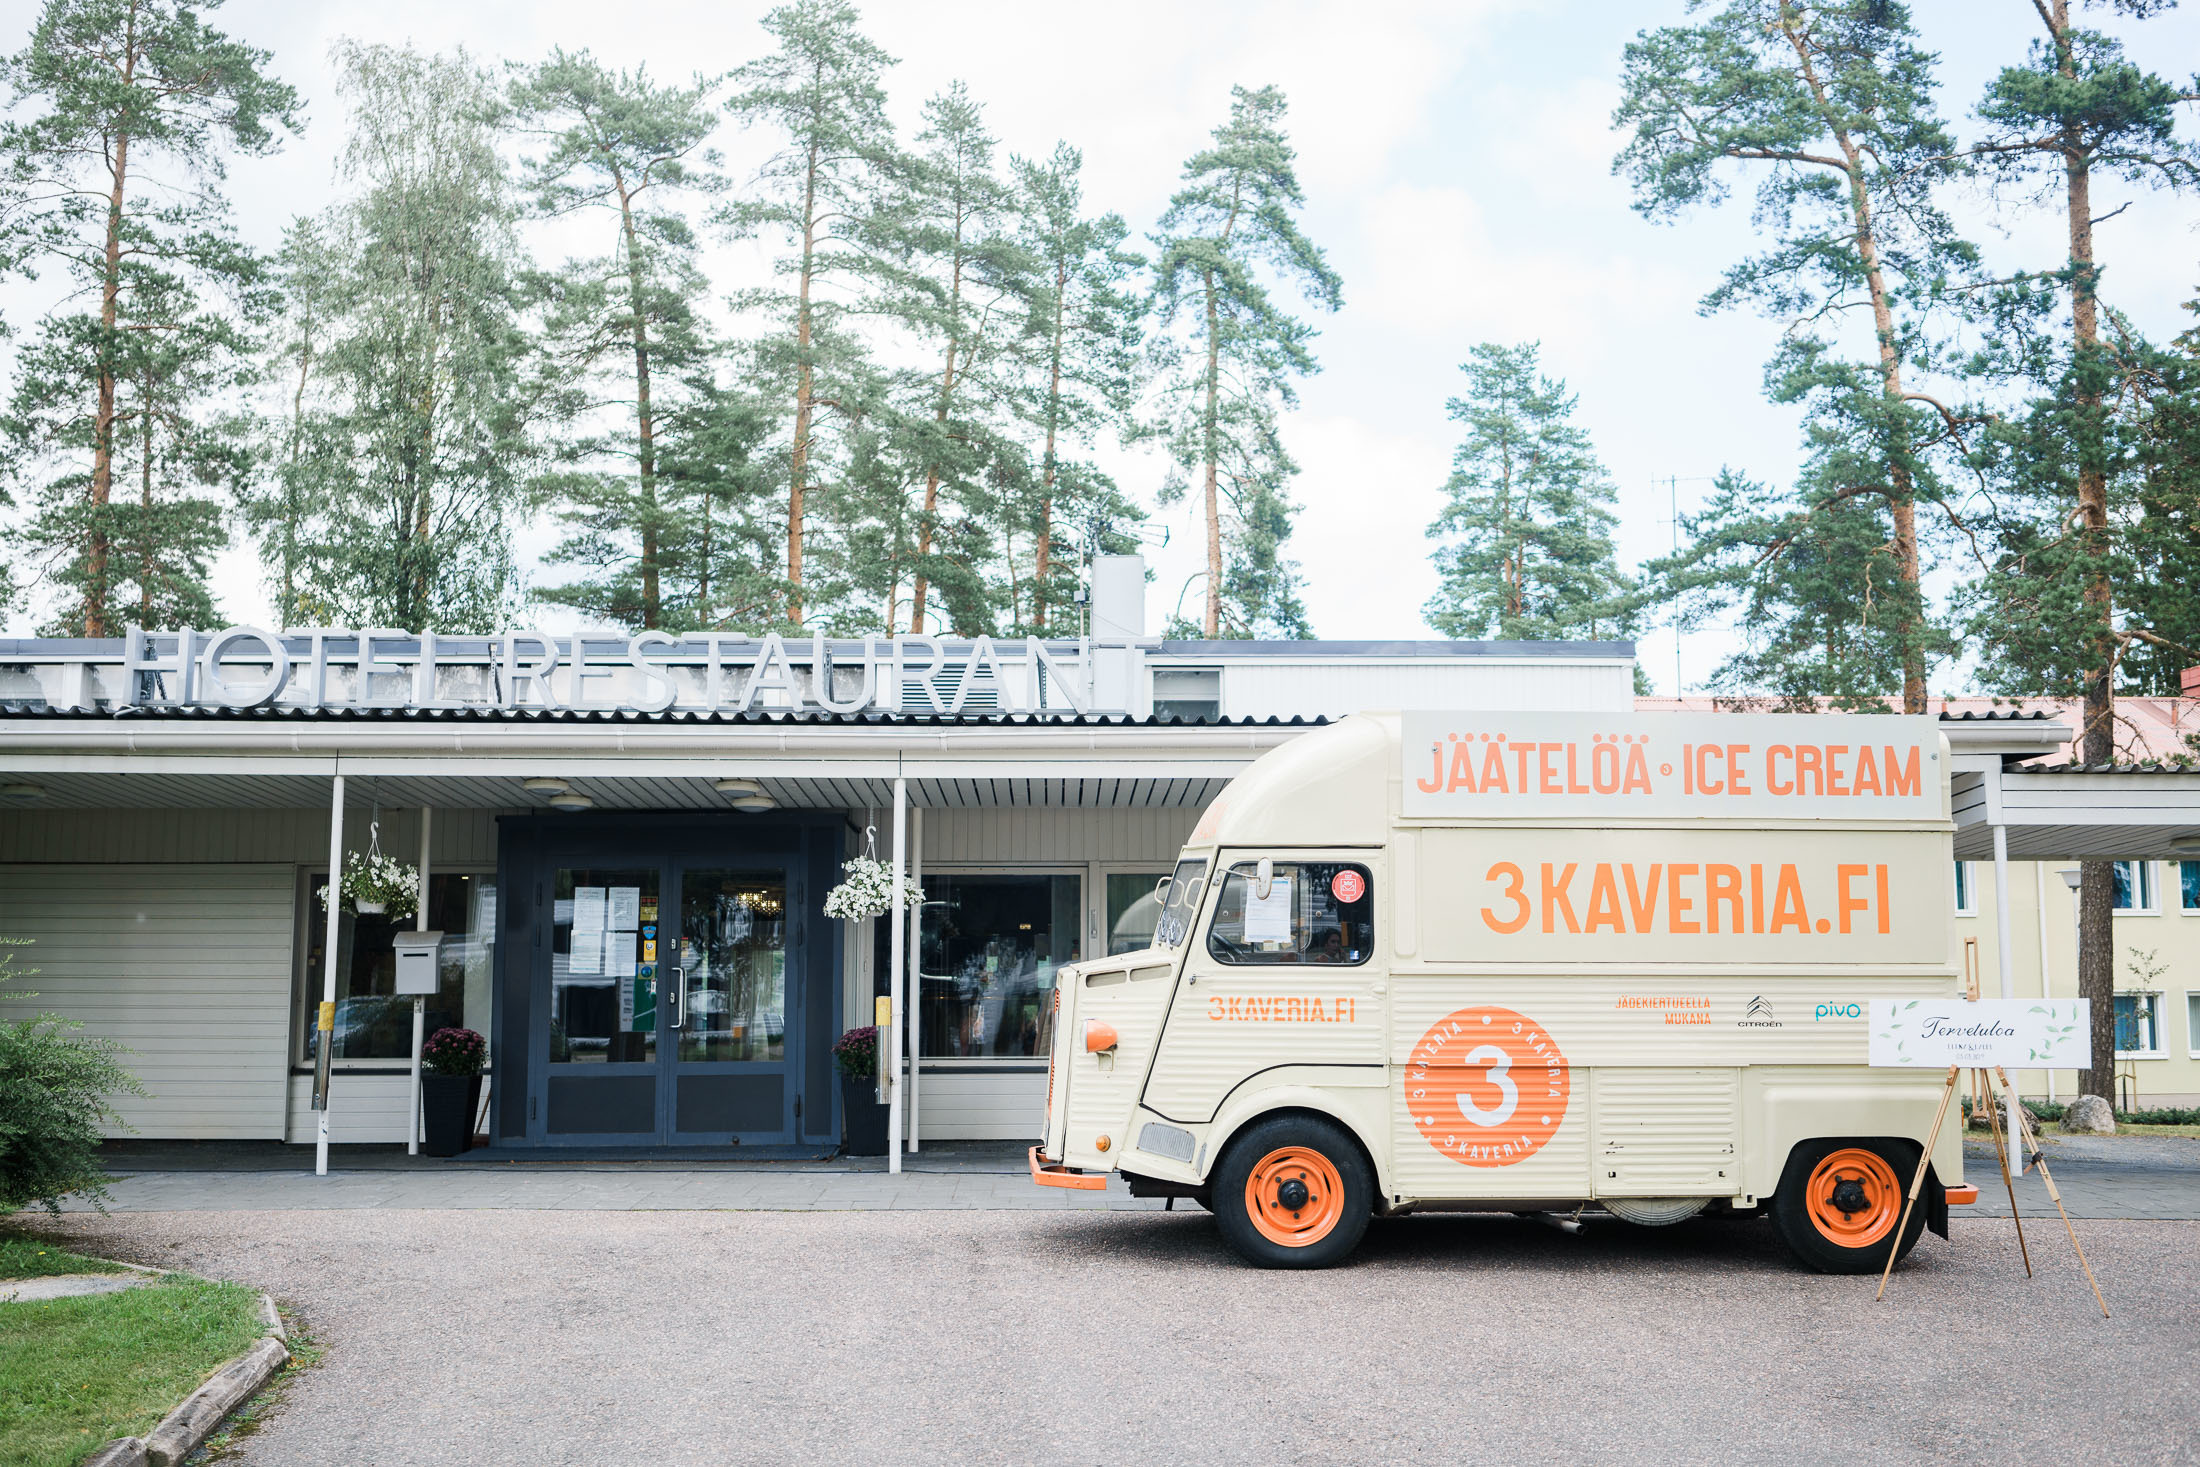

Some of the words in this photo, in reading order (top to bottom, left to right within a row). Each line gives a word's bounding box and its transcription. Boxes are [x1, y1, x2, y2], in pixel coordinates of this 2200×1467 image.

[123, 625, 467, 710] HOTEL
[502, 629, 1163, 716] RESTAURANT
[1417, 733, 1653, 795] JÄÄTELÖÄ
[1684, 744, 1752, 796] ICE
[1766, 744, 1922, 797] CREAM
[1480, 861, 1890, 935] 3KAVERIA.FI
[1208, 996, 1355, 1023] 3KAVERIA.FI
[1664, 1012, 1712, 1025] MUKANA
[1815, 1001, 1861, 1022] pivo
[1921, 1016, 2015, 1039] Tervetuloa
[1456, 1044, 1519, 1127] 3
